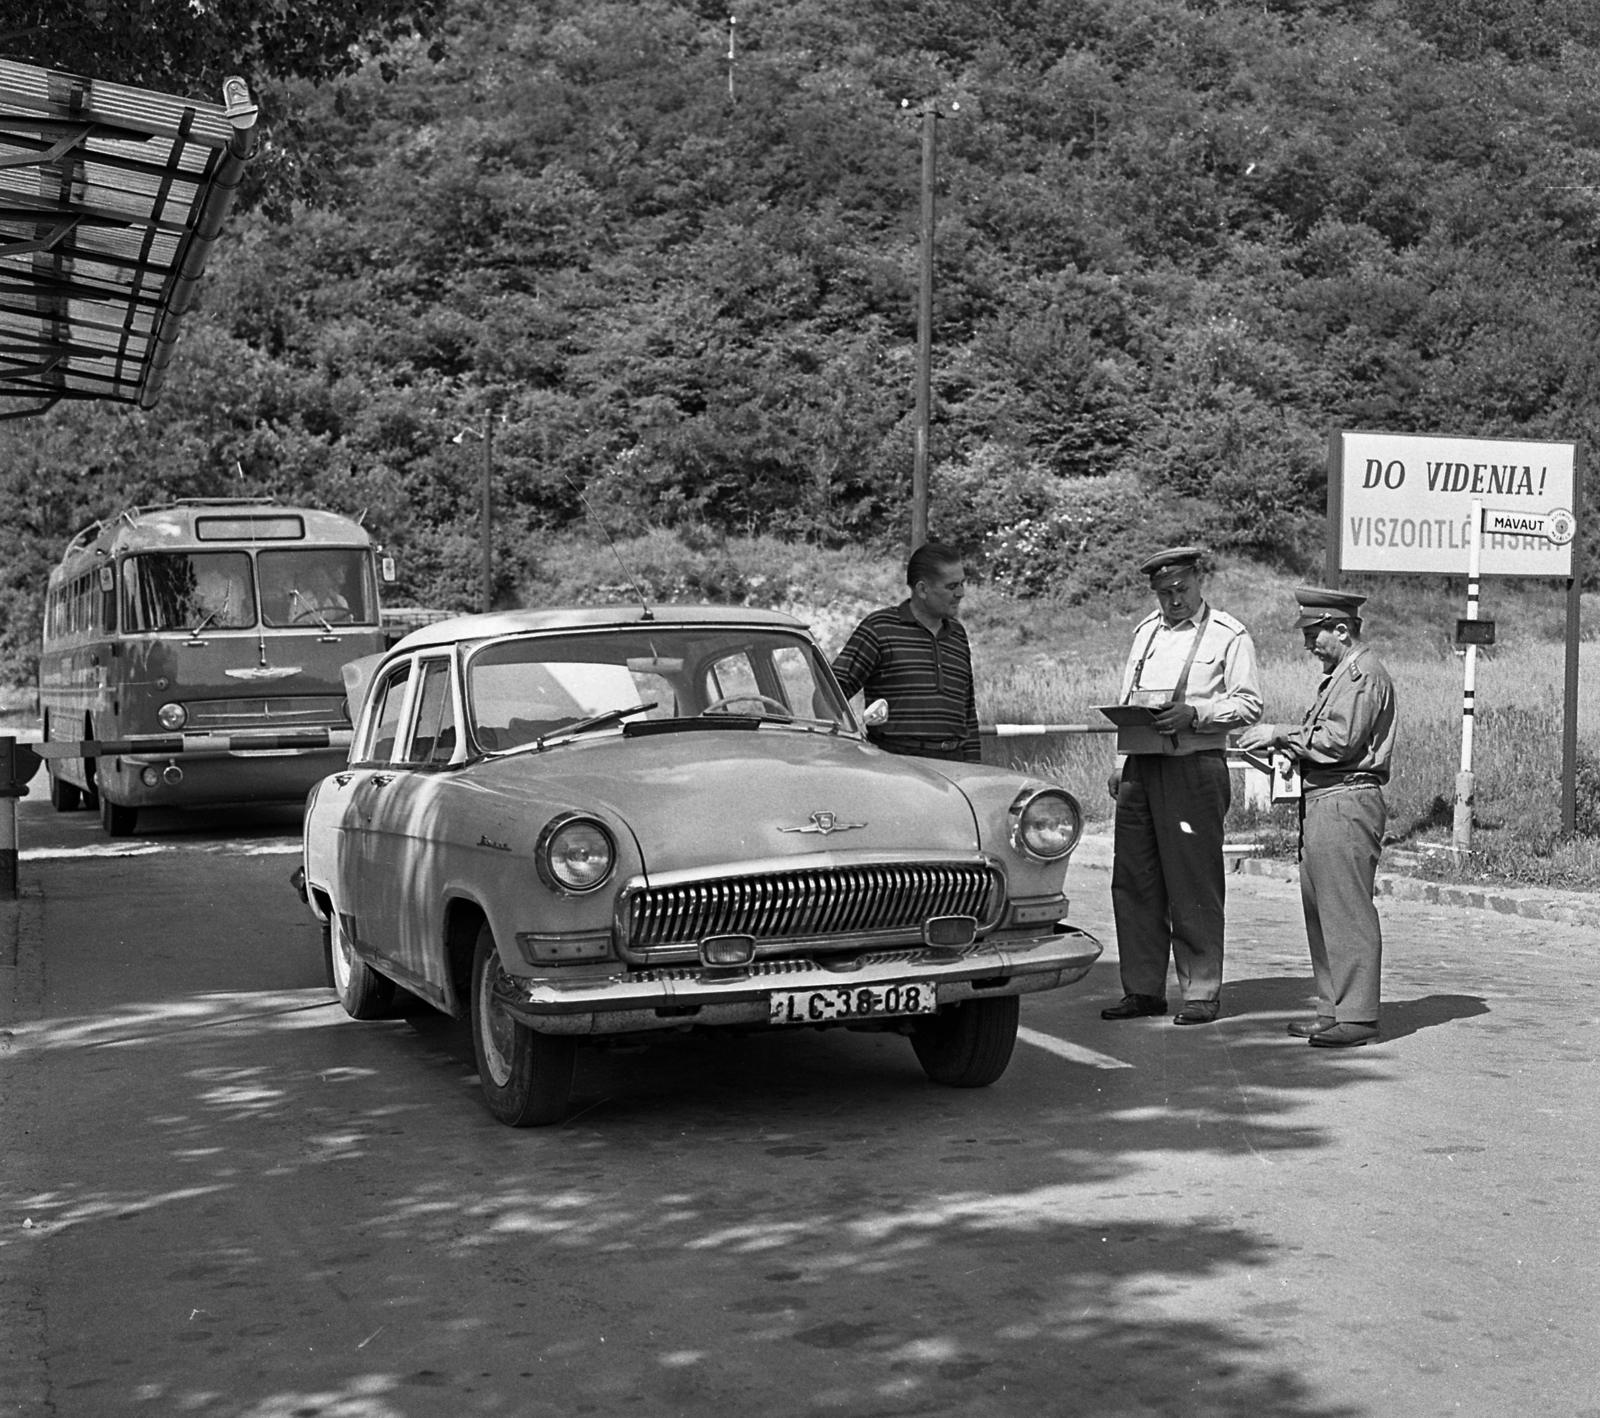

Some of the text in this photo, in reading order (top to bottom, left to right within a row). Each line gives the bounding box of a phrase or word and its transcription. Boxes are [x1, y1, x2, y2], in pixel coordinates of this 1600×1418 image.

[1362, 459, 1547, 496] DO VIDENIA!
[1350, 514, 1561, 551] VISZONTLÁ
[1494, 515, 1545, 531] MÁVAUT
